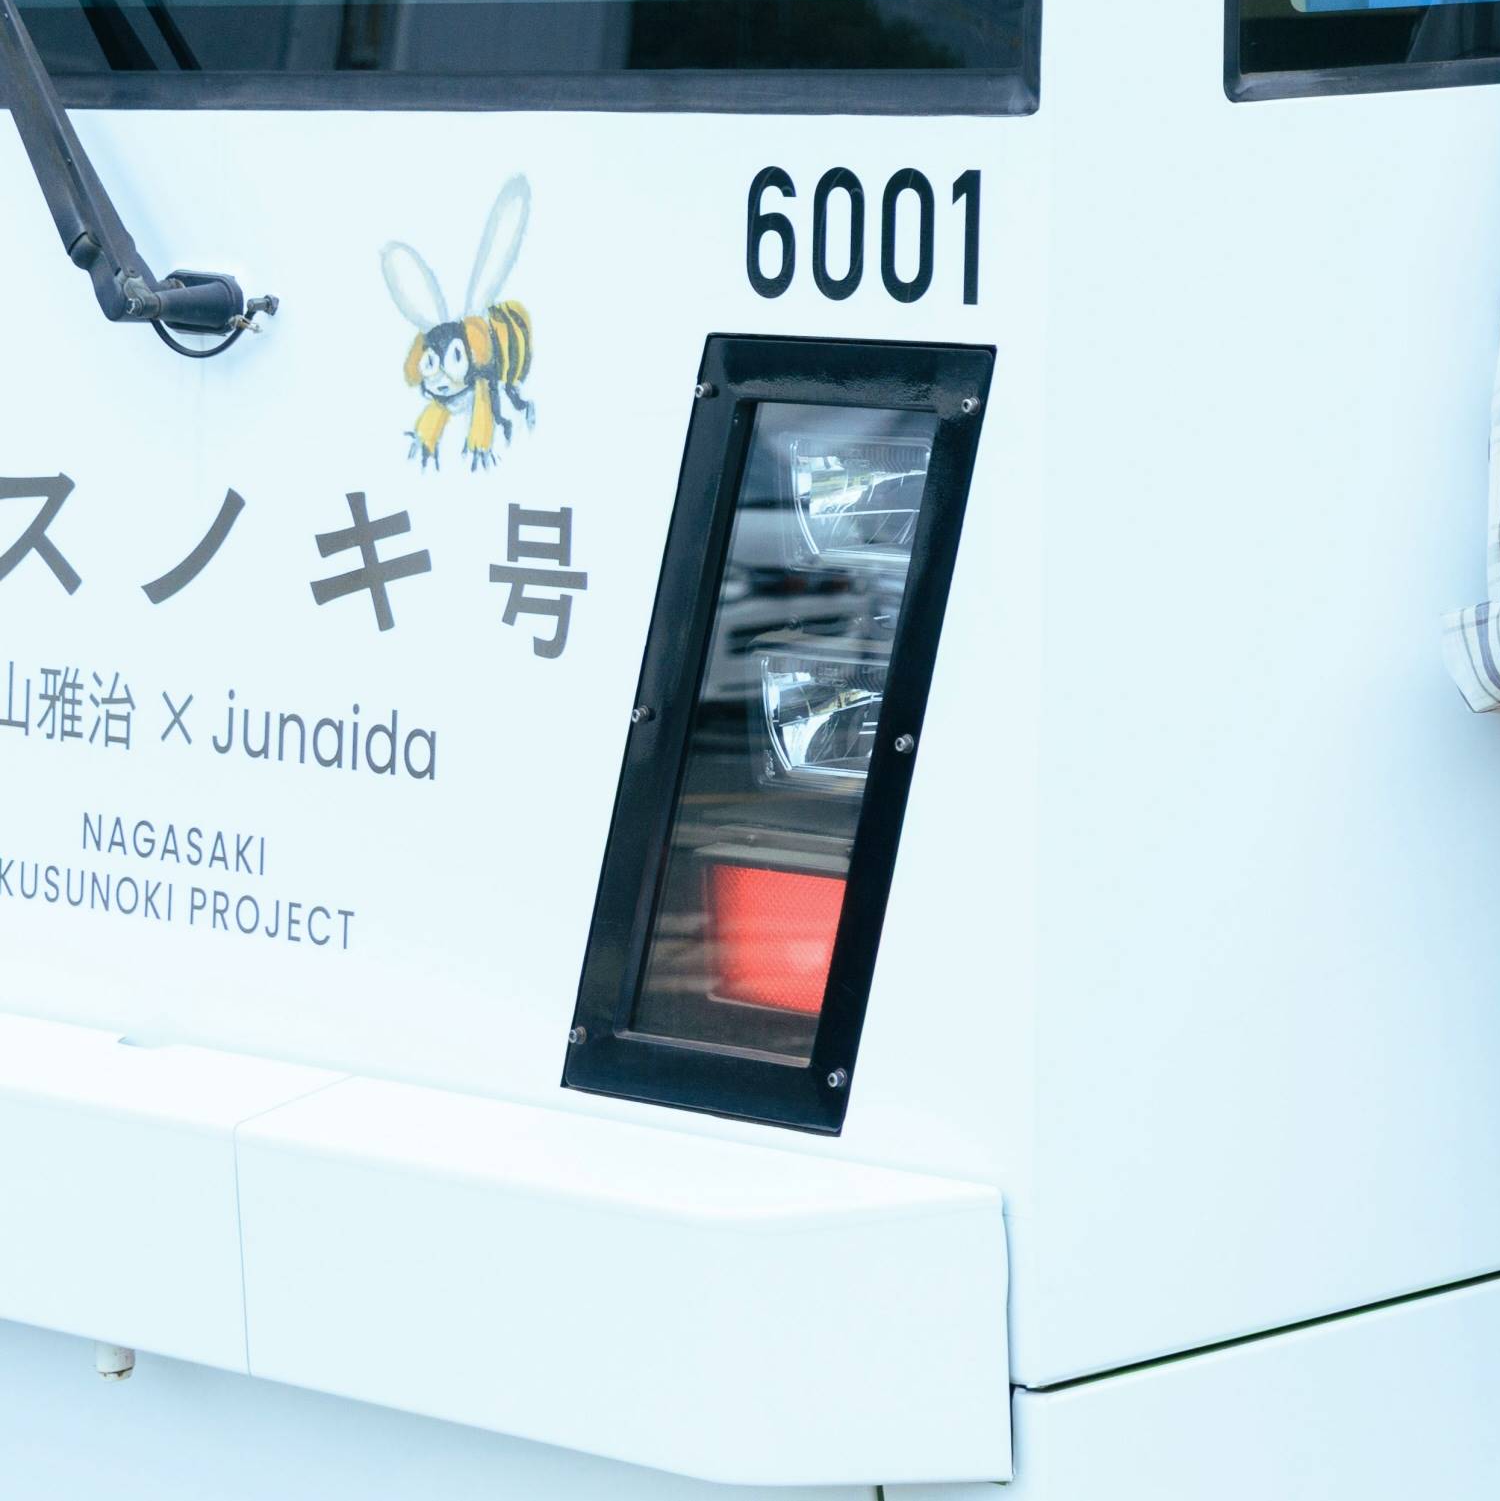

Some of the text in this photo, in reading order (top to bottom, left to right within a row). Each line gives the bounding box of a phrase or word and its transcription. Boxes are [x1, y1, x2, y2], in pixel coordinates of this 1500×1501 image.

[747, 166, 982, 306] 6001
[0, 471, 588, 660] スノキ号
[0, 660, 137, 751] 山雅治
[211, 688, 438, 781] junaida
[0, 857, 356, 950] KUSUNOKI PROJECT
[82, 811, 266, 876] NAGASAKI
